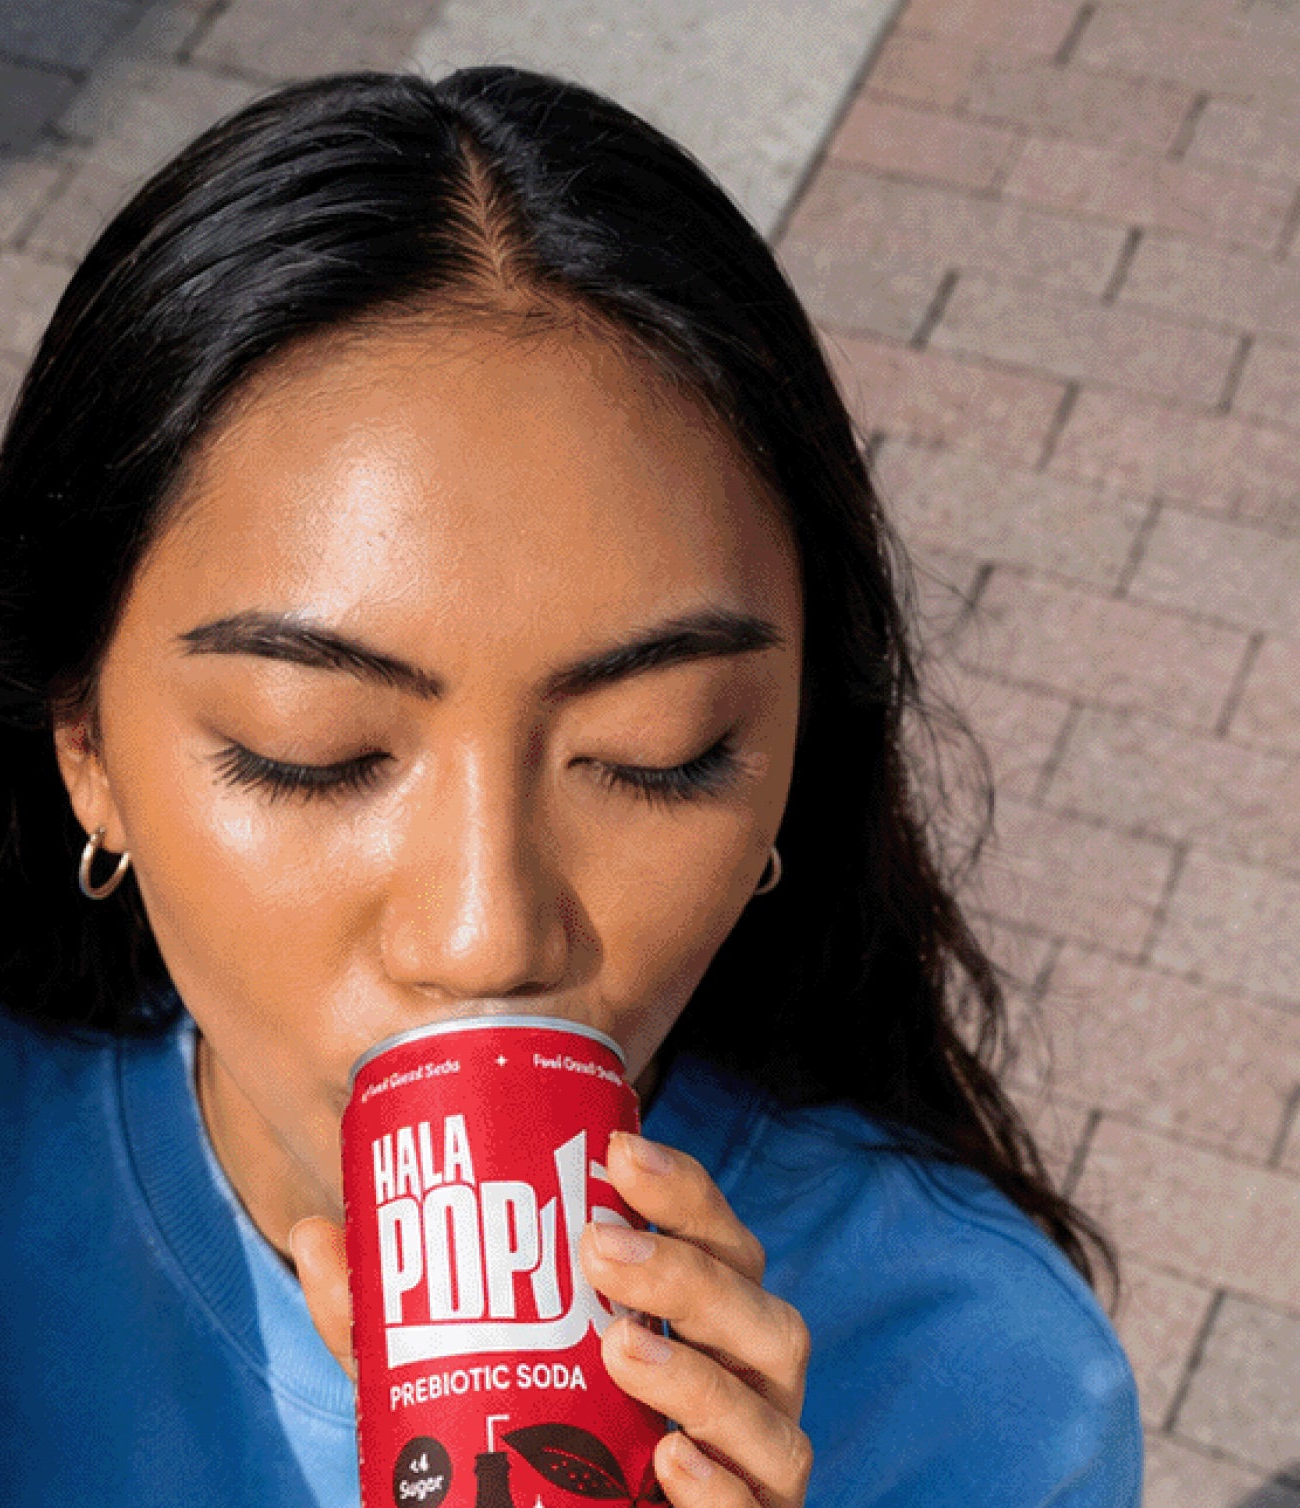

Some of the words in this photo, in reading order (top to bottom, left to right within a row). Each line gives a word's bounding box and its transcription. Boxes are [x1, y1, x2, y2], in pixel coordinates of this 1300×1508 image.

[372, 1113, 476, 1205] HALA
[377, 1180, 540, 1325] POP
[390, 1364, 511, 1411] PREBIOTIC
[516, 1363, 587, 1391] SODA
[399, 1475, 444, 1501] Sugar
